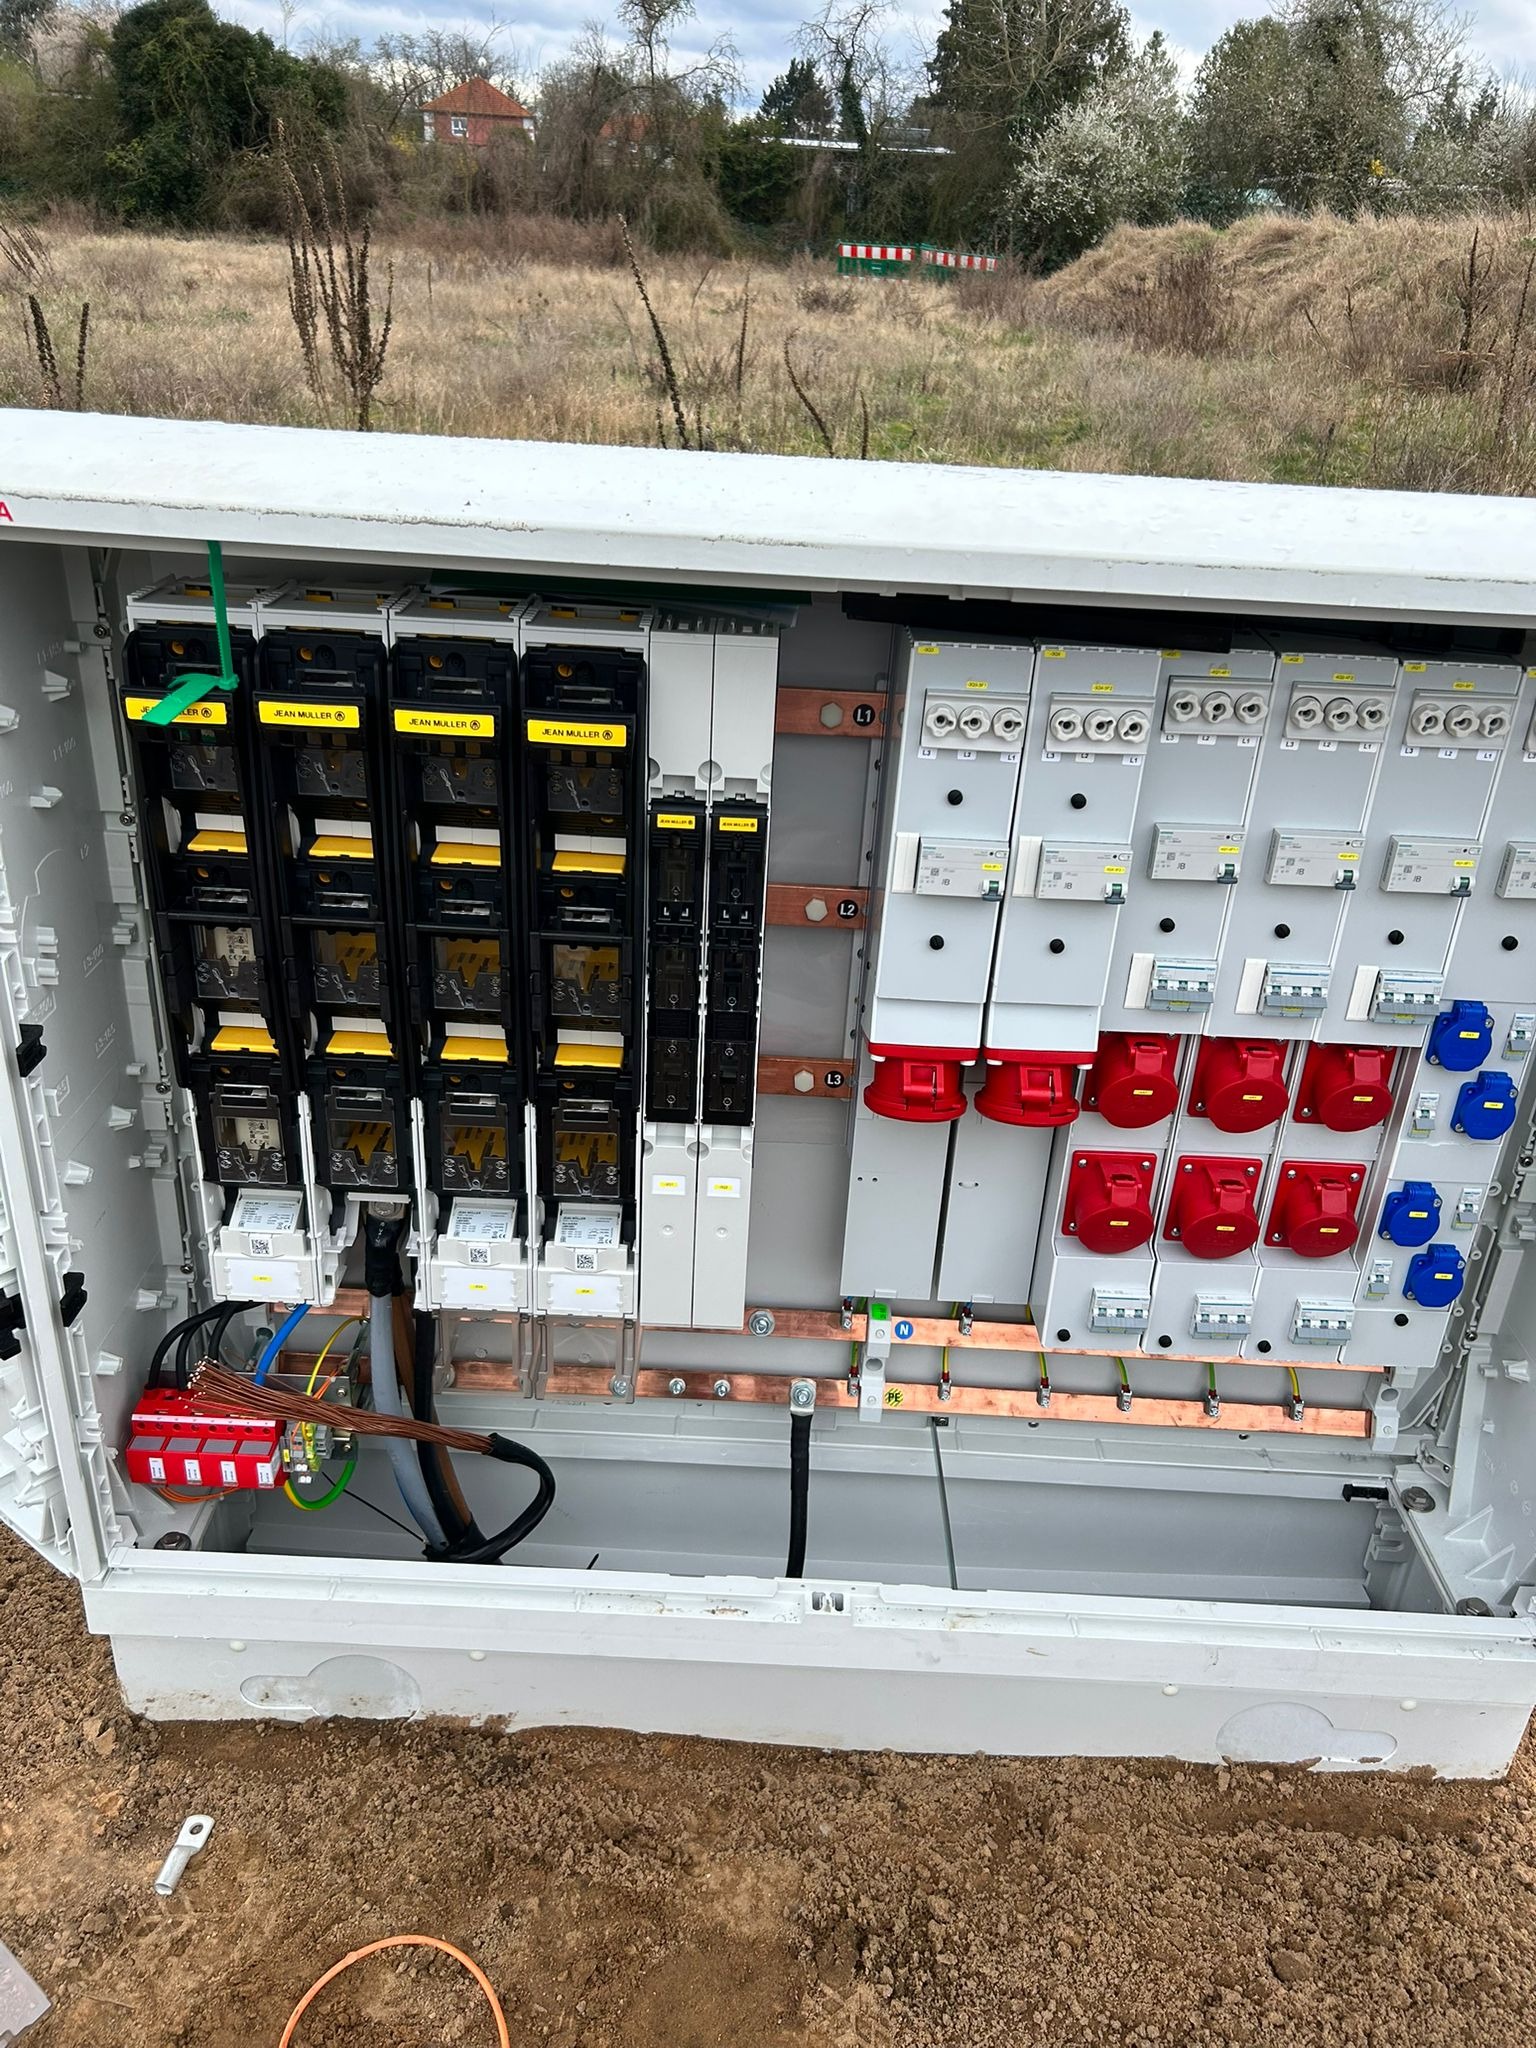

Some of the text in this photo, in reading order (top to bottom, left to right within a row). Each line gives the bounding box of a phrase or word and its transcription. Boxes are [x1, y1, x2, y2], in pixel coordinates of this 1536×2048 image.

[274, 709, 296, 718] JEAN
[857, 708, 871, 722] L1
[409, 718, 431, 726] JEAN
[542, 728, 564, 737] JEAN
[840, 904, 855, 916] L2
[827, 1073, 841, 1085] L3
[899, 1323, 909, 1336] N
[888, 1392, 901, 1402] PE
